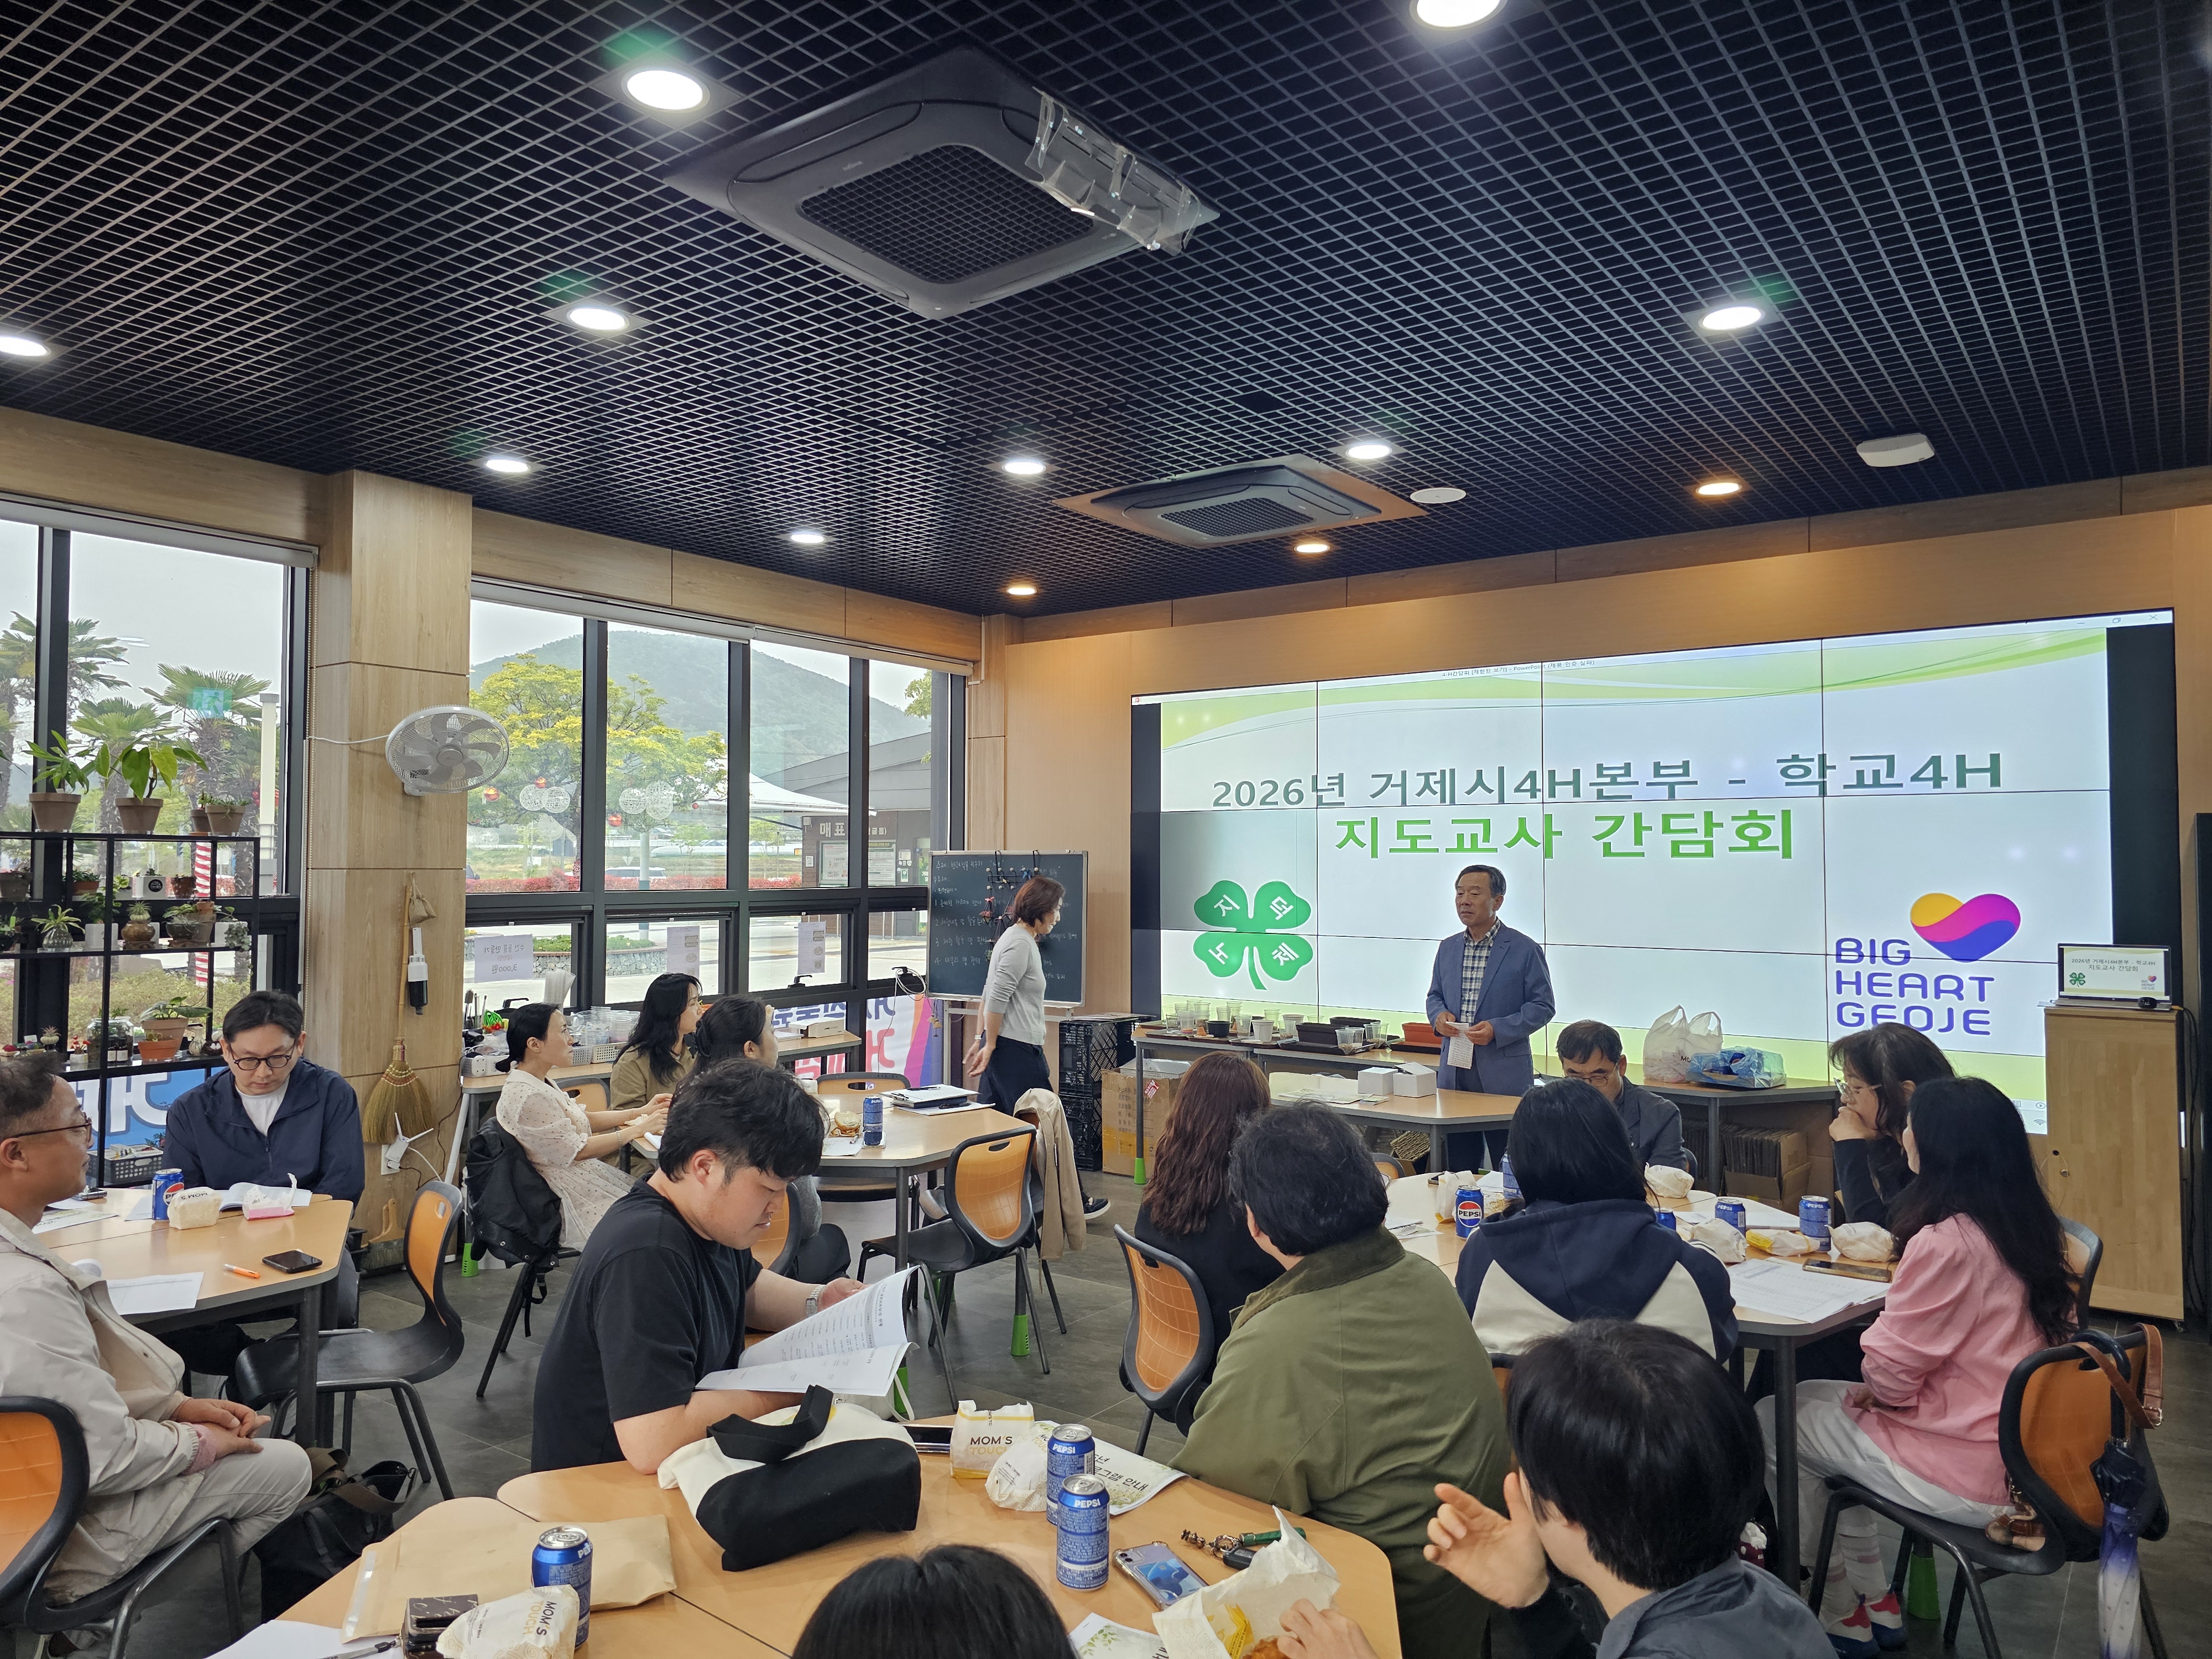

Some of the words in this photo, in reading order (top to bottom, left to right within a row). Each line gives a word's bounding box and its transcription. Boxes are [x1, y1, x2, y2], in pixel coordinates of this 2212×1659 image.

[1213, 773, 1345, 807] 2026년
[1369, 760, 1698, 806] 거제시4H본부
[1776, 753, 2001, 796] 학교4H
[820, 822, 846, 838] 매표
[1335, 813, 1563, 859] 지도교사
[1591, 809, 1792, 859] 간담회
[1214, 894, 1240, 917] 지
[1269, 896, 1293, 920] 덕
[1208, 942, 1229, 964] 노
[1271, 942, 1300, 966] 체
[1835, 937, 1911, 966] BIG
[1835, 969, 1995, 1002] HEART
[1837, 1001, 1991, 1036] GEOJE
[970, 1435, 1013, 1445] MOM'S
[1053, 1443, 1076, 1454] PEPSI
[1094, 1465, 1124, 1481] 로그램
[1122, 1478, 1149, 1491] 안내
[1074, 1498, 1101, 1508] PEPSI
[536, 1600, 557, 1636] MOM'S
